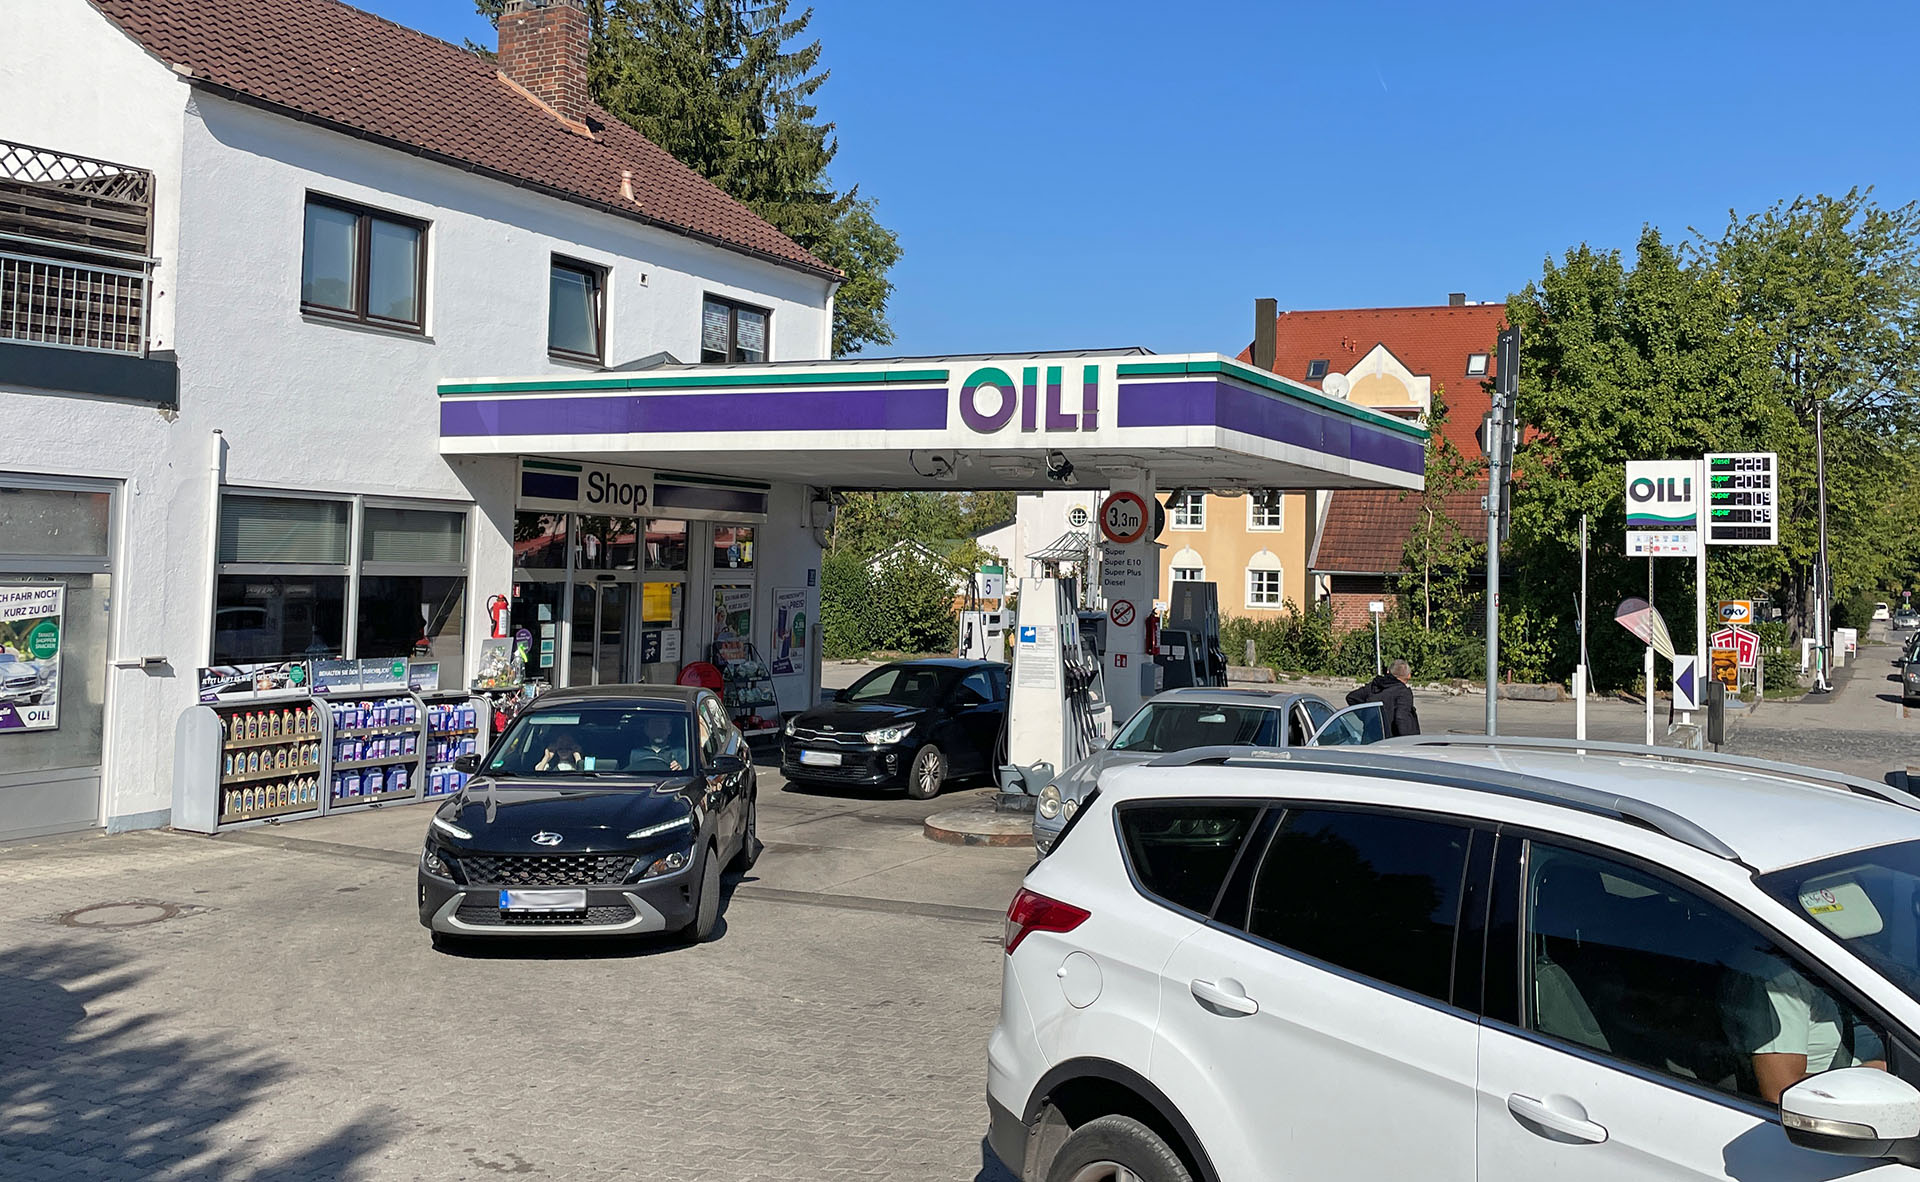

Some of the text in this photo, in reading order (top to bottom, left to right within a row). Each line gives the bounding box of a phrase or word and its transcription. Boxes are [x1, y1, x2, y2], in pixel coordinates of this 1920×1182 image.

[959, 365, 1099, 434] OIL!
[586, 471, 648, 513] Shop
[1629, 477, 1691, 503] OIL!
[1105, 548, 1126, 556] Super
[1105, 559, 1125, 567] Super
[1104, 568, 1142, 577] Super Plus
[985, 579, 992, 595] 5
[10, 592, 33, 601] FAHR
[35, 590, 57, 599] NOCH
[4, 607, 27, 618] KURZ
[29, 606, 41, 615] ZU
[1723, 608, 1746, 616] DKV
[1087, 655, 1093, 671] 3
[28, 710, 50, 721] OIL!
